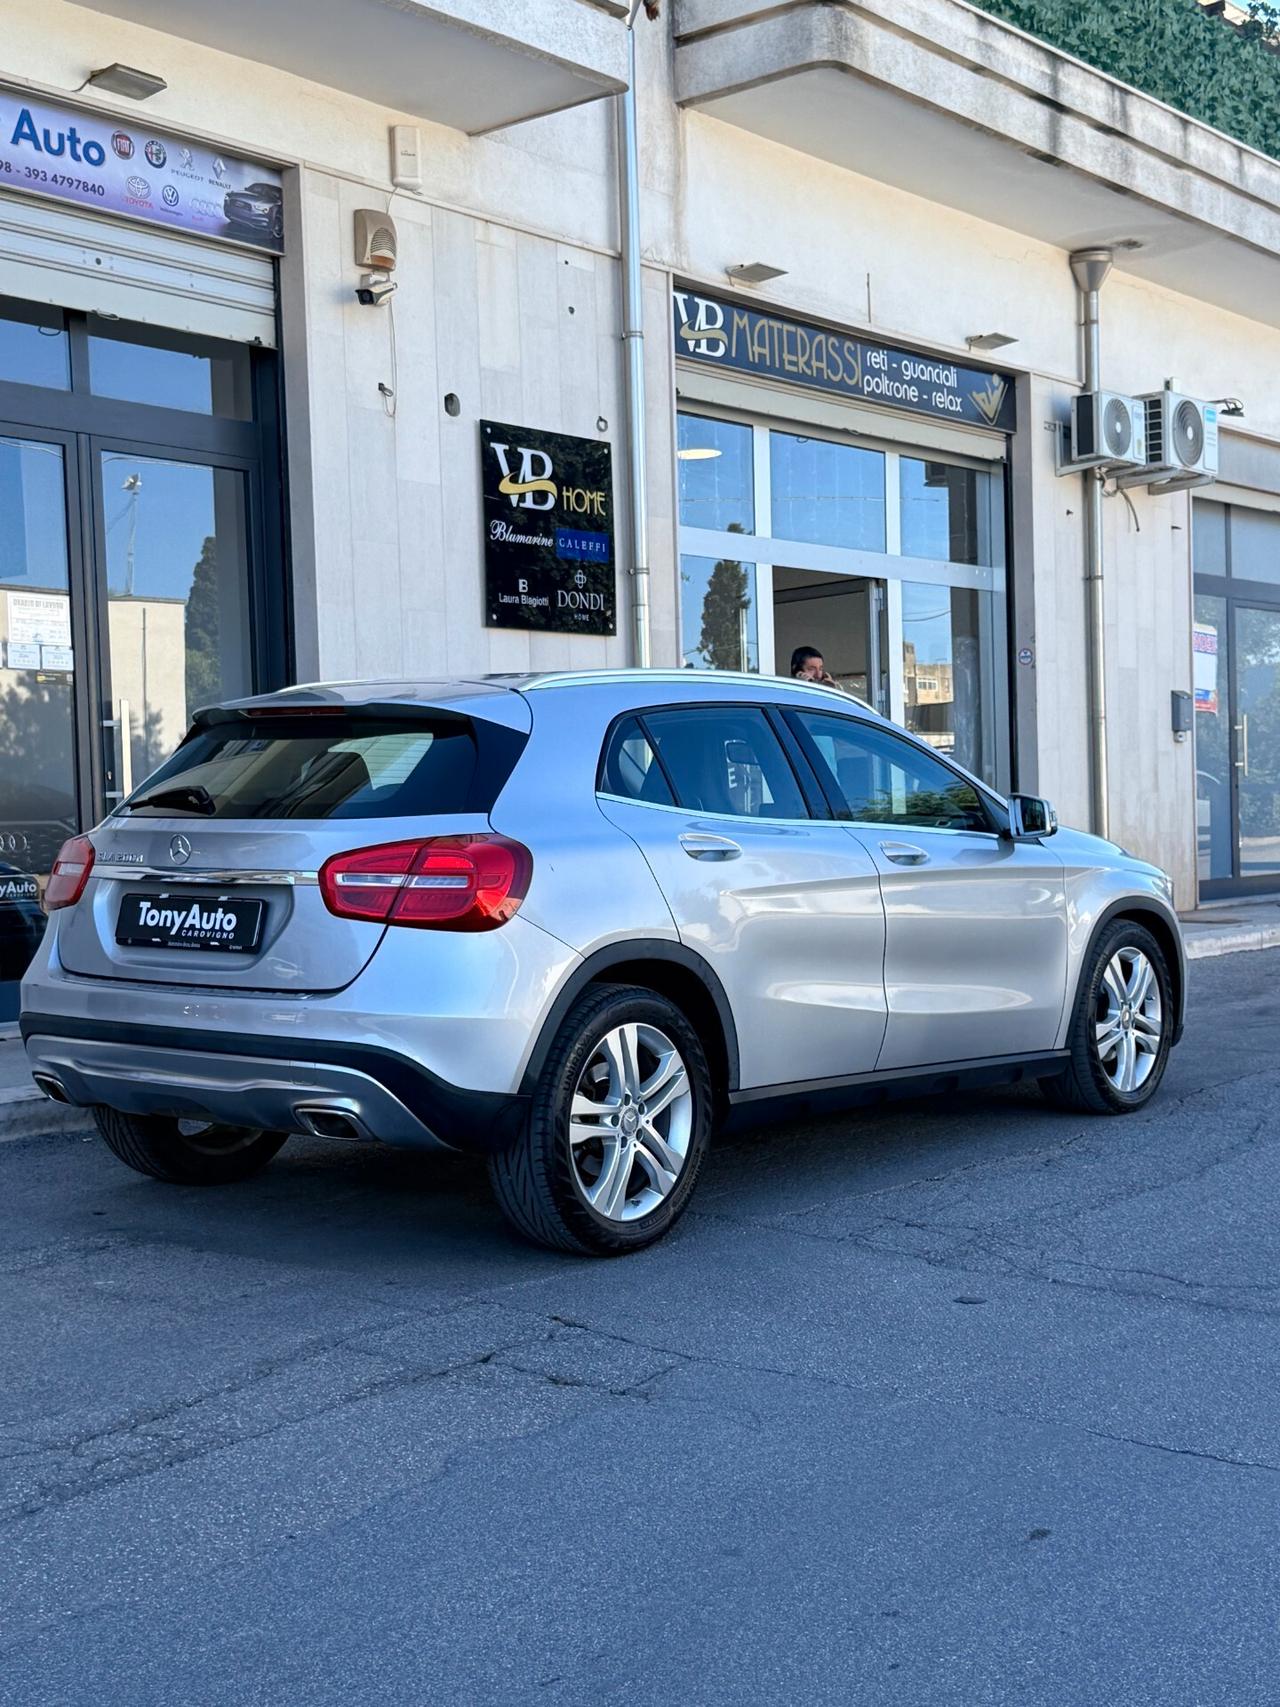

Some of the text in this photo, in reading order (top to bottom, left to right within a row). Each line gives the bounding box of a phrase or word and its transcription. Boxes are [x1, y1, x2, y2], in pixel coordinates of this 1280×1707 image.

[10, 108, 106, 167] Auto
[25, 167, 48, 182] 393
[51, 174, 105, 196] 4797840
[125, 196, 154, 209] TOYOTA
[731, 310, 862, 389] MATERASSI
[866, 350, 888, 371] reti
[901, 360, 957, 388] guanciali
[863, 373, 919, 402] poltrone
[932, 388, 962, 412] relax
[562, 486, 606, 516] HOME
[490, 520, 554, 547] Blumarine
[559, 537, 606, 553] CALEFFI
[499, 592, 520, 604] Laura
[557, 590, 605, 611] DONDI
[139, 901, 237, 935] TonyAuto
[181, 929, 235, 940] CAROVIGNO
